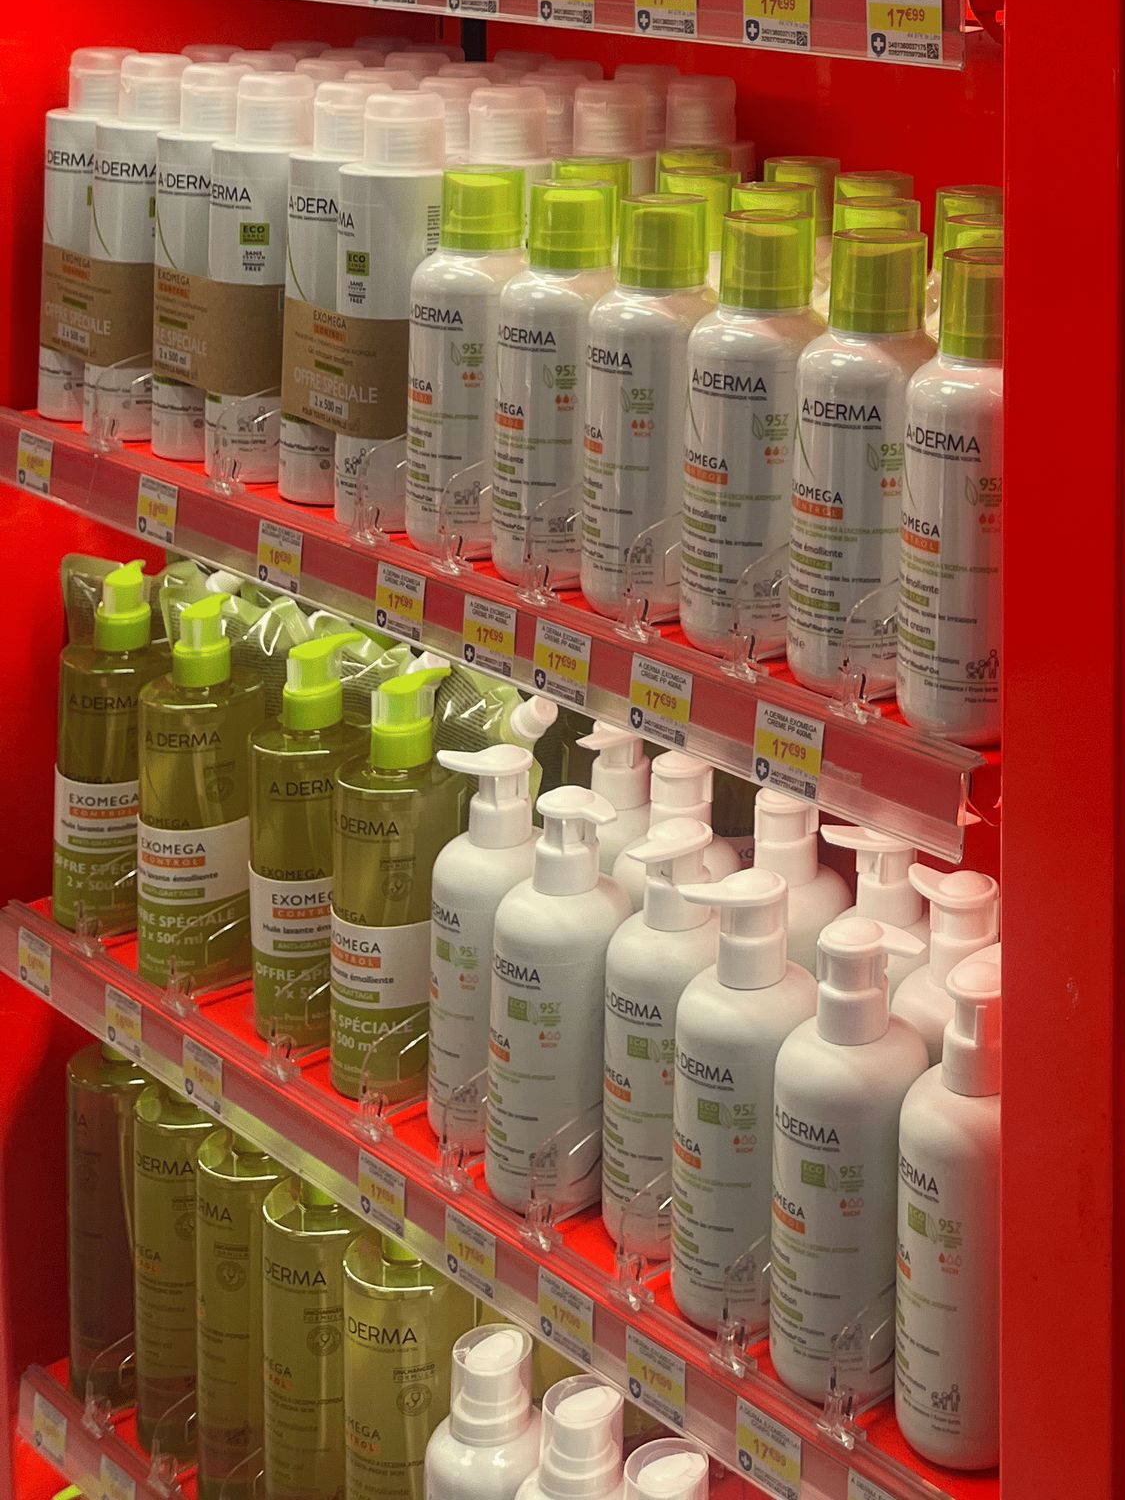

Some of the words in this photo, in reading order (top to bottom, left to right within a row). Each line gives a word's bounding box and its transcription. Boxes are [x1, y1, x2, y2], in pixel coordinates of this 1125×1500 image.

[887, 8, 926, 27] 17€99
[313, 309, 347, 329] EXOMEGA
[294, 366, 322, 394] OFFRE
[322, 373, 378, 403] SPÉCIALE
[324, 398, 335, 413] 500
[811, 587, 835, 597] cream
[476, 627, 504, 643] 17€99
[548, 652, 577, 670] 17€99
[772, 739, 806, 759] 17€99
[69, 793, 139, 807] EXOMEGA
[141, 836, 206, 855] EXOMEGA
[283, 925, 315, 935] lavante
[255, 962, 295, 982] OFFRE
[350, 973, 394, 984] émolliente
